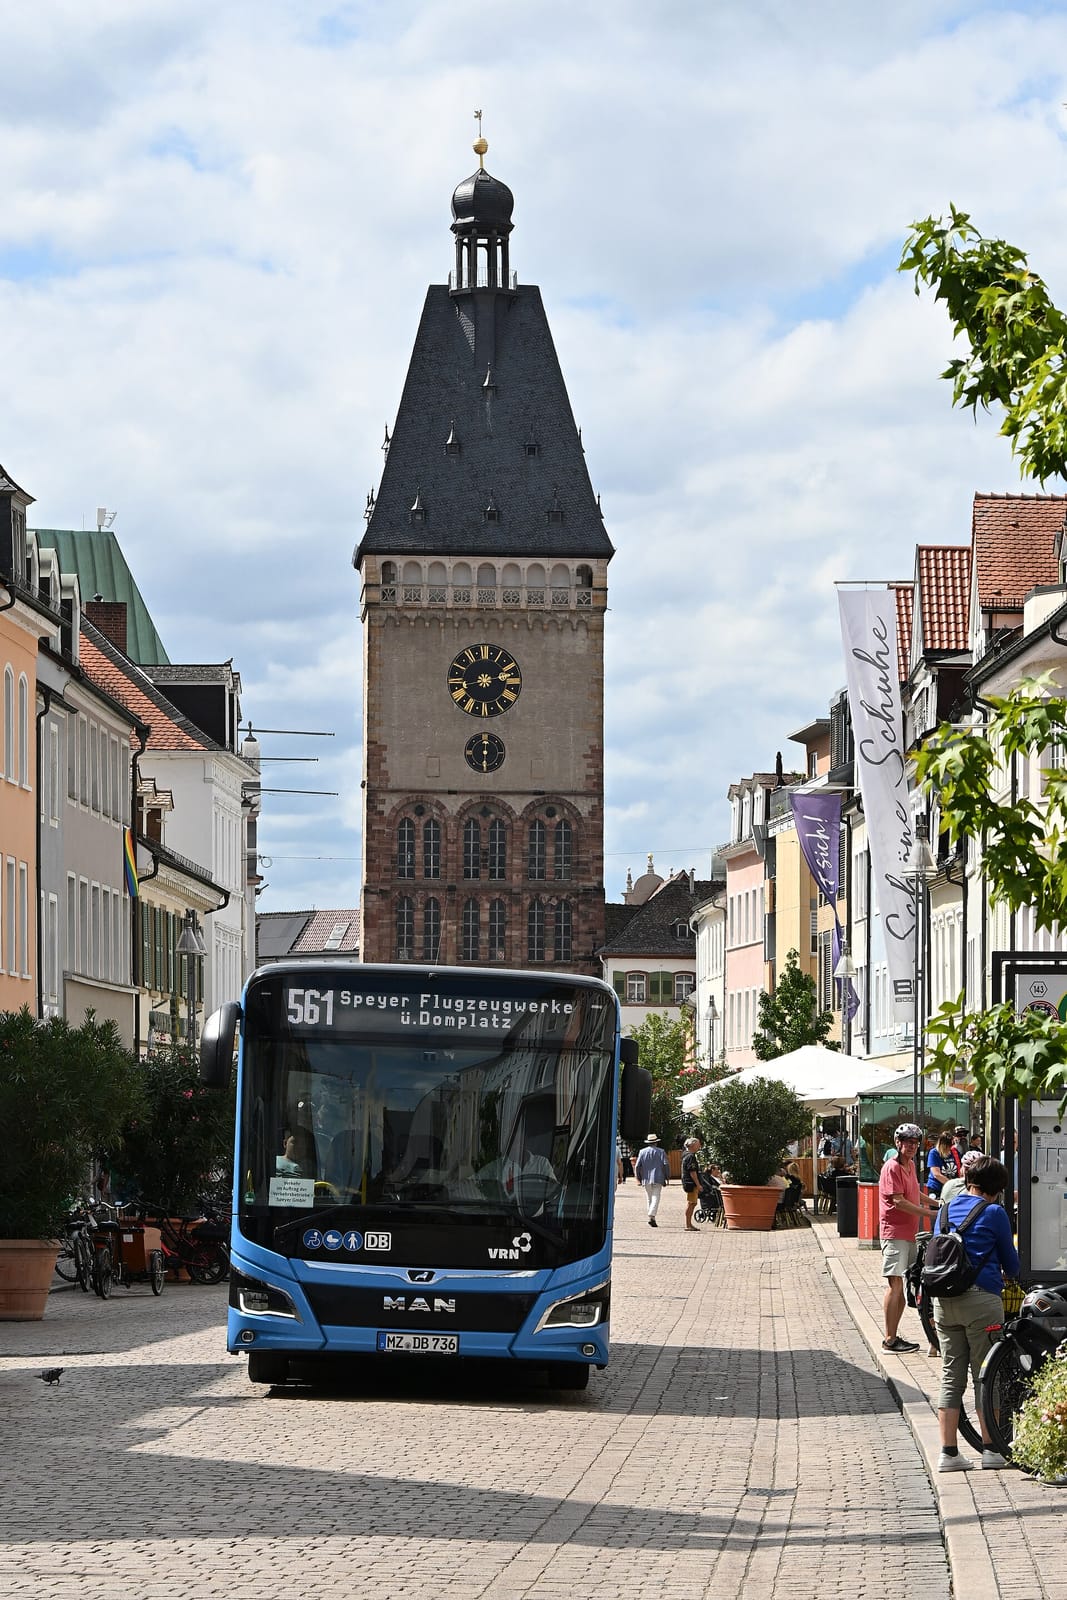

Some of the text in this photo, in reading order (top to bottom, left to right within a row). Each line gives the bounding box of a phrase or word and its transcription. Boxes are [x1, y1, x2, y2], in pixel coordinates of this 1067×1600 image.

[851, 615, 905, 788] Schuhe
[803, 815, 833, 869] sich!
[1033, 985, 1045, 994] 143
[287, 988, 573, 1025] 561 Speyer Flugzeugwerke
[400, 1011, 512, 1030] ü.Domplatz
[366, 1234, 390, 1249] DB
[487, 1247, 520, 1260] VRN
[383, 1295, 456, 1313] MAN
[387, 1336, 404, 1348] MZ
[412, 1336, 429, 1350] DB
[432, 1338, 456, 1350] 736
